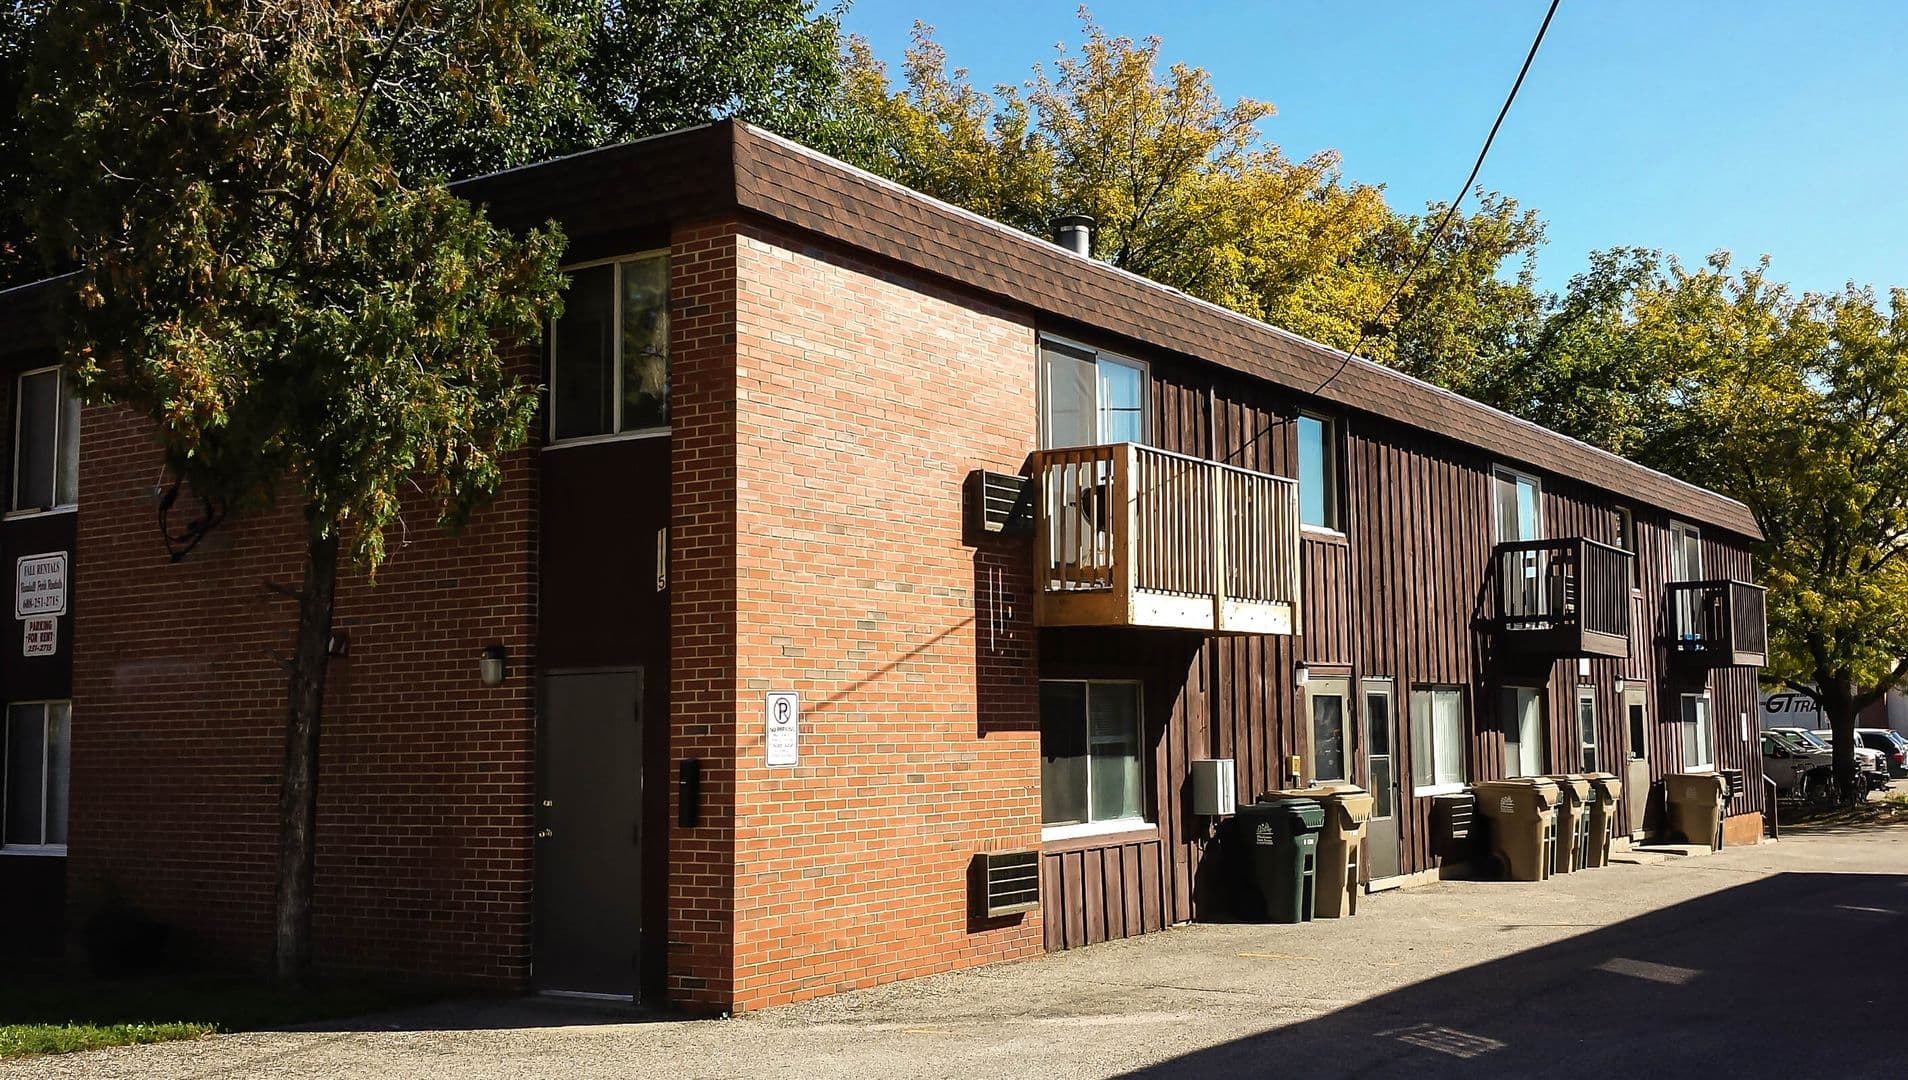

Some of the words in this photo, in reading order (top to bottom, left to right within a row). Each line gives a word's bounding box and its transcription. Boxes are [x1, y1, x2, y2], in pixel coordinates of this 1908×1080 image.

[36, 563, 60, 575] RENTALS
[29, 620, 52, 632] PARKING
[28, 632, 38, 643] FOR
[40, 631, 53, 642] RENT
[1766, 693, 1797, 713] GT
